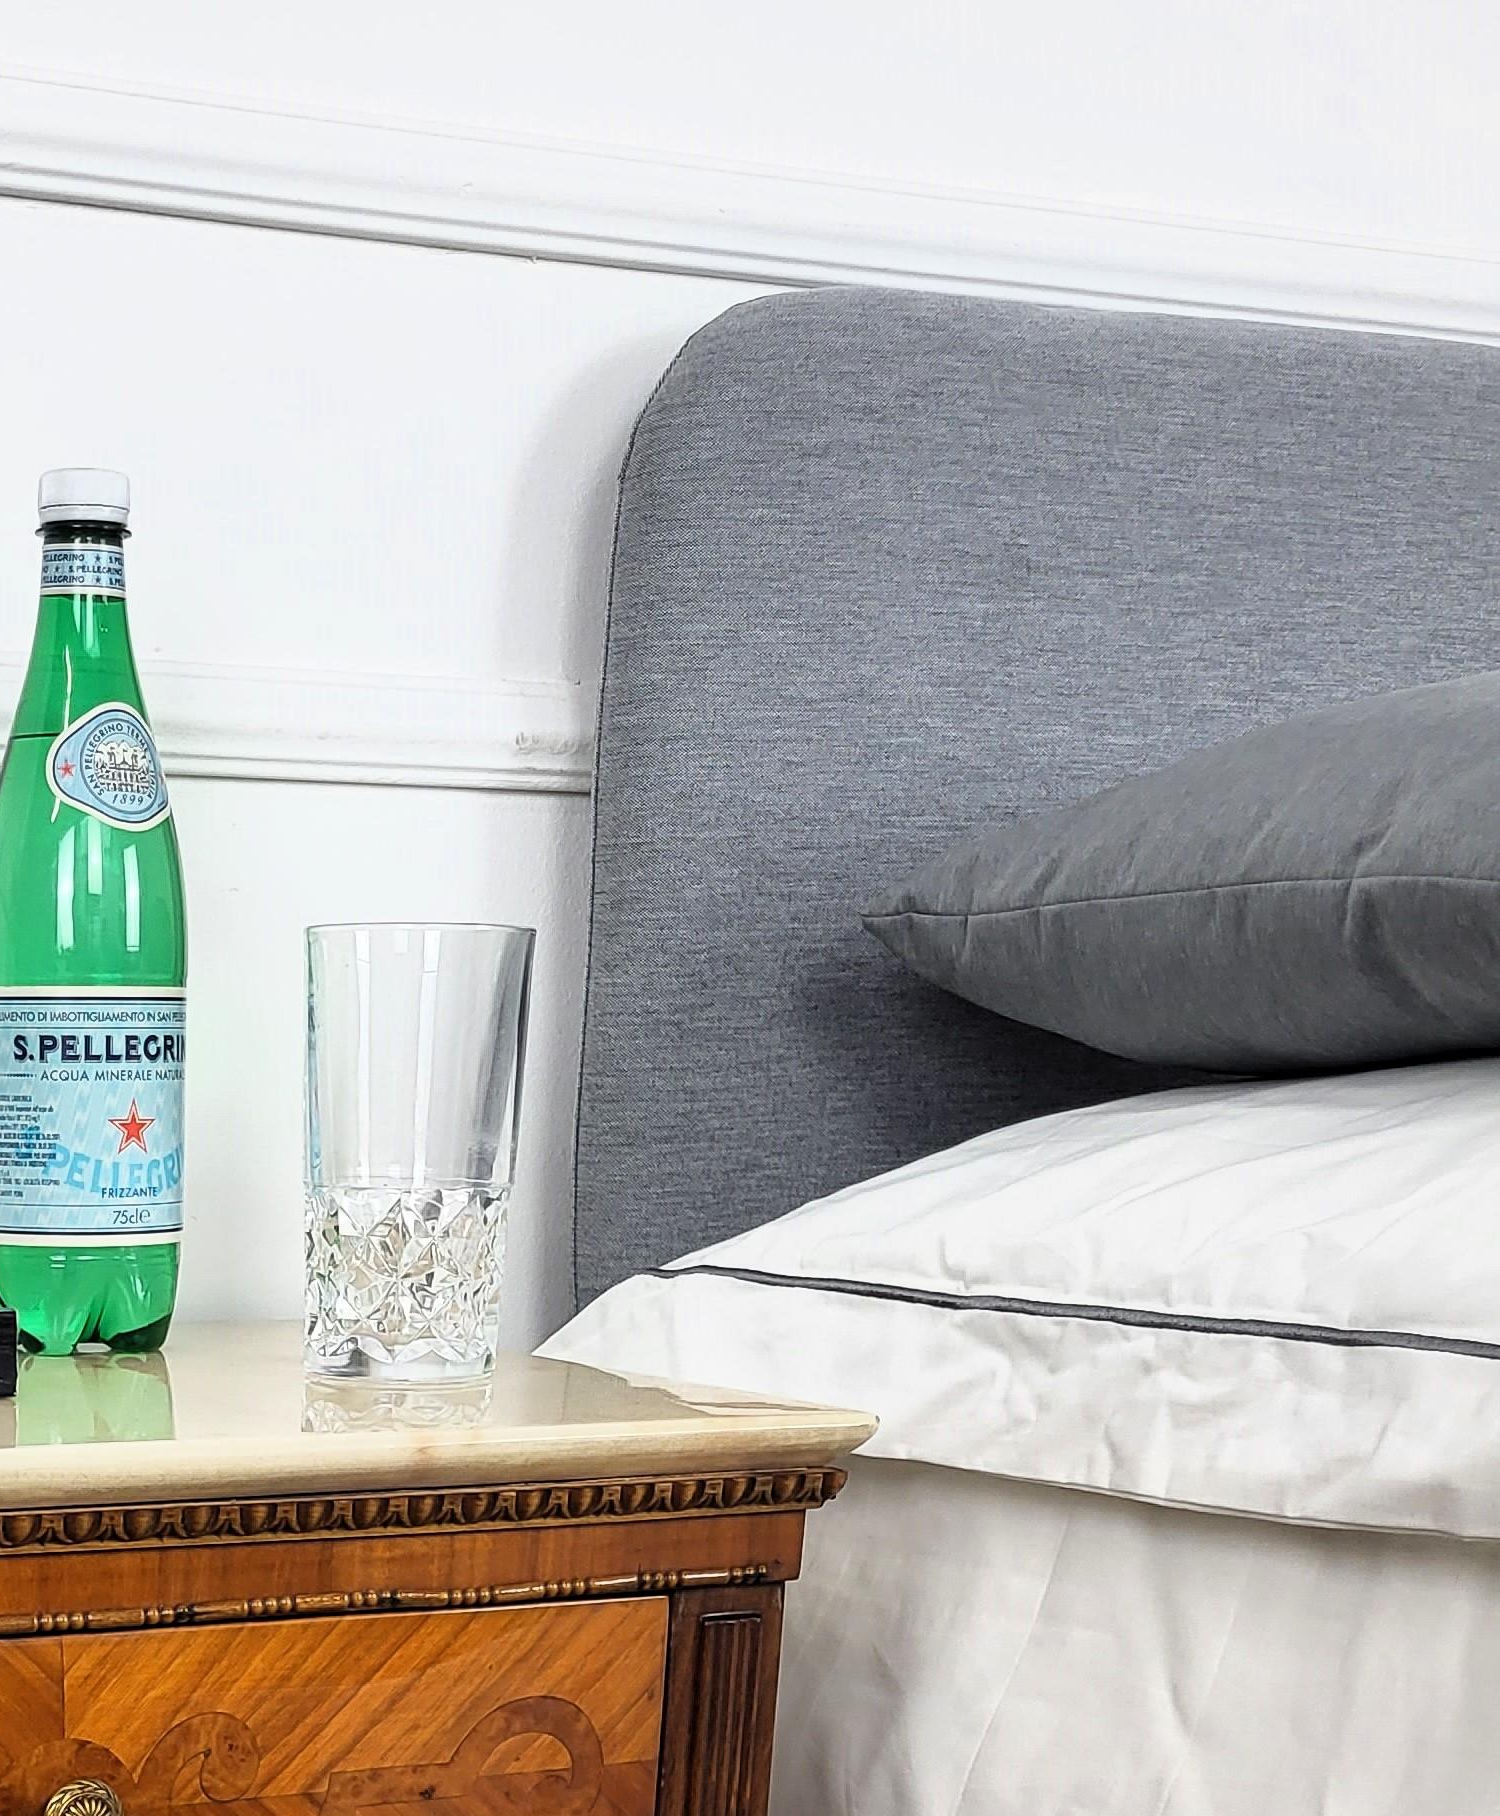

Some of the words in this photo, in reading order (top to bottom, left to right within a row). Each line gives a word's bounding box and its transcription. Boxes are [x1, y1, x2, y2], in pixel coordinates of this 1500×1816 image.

[84, 722, 124, 771] PELLEGRINO
[112, 793, 144, 806] 1899
[37, 1011, 48, 1021] DI
[40, 1069, 90, 1082] ACQUA
[94, 1069, 152, 1081] MINERALE
[101, 1186, 158, 1199] FRIZZANTE
